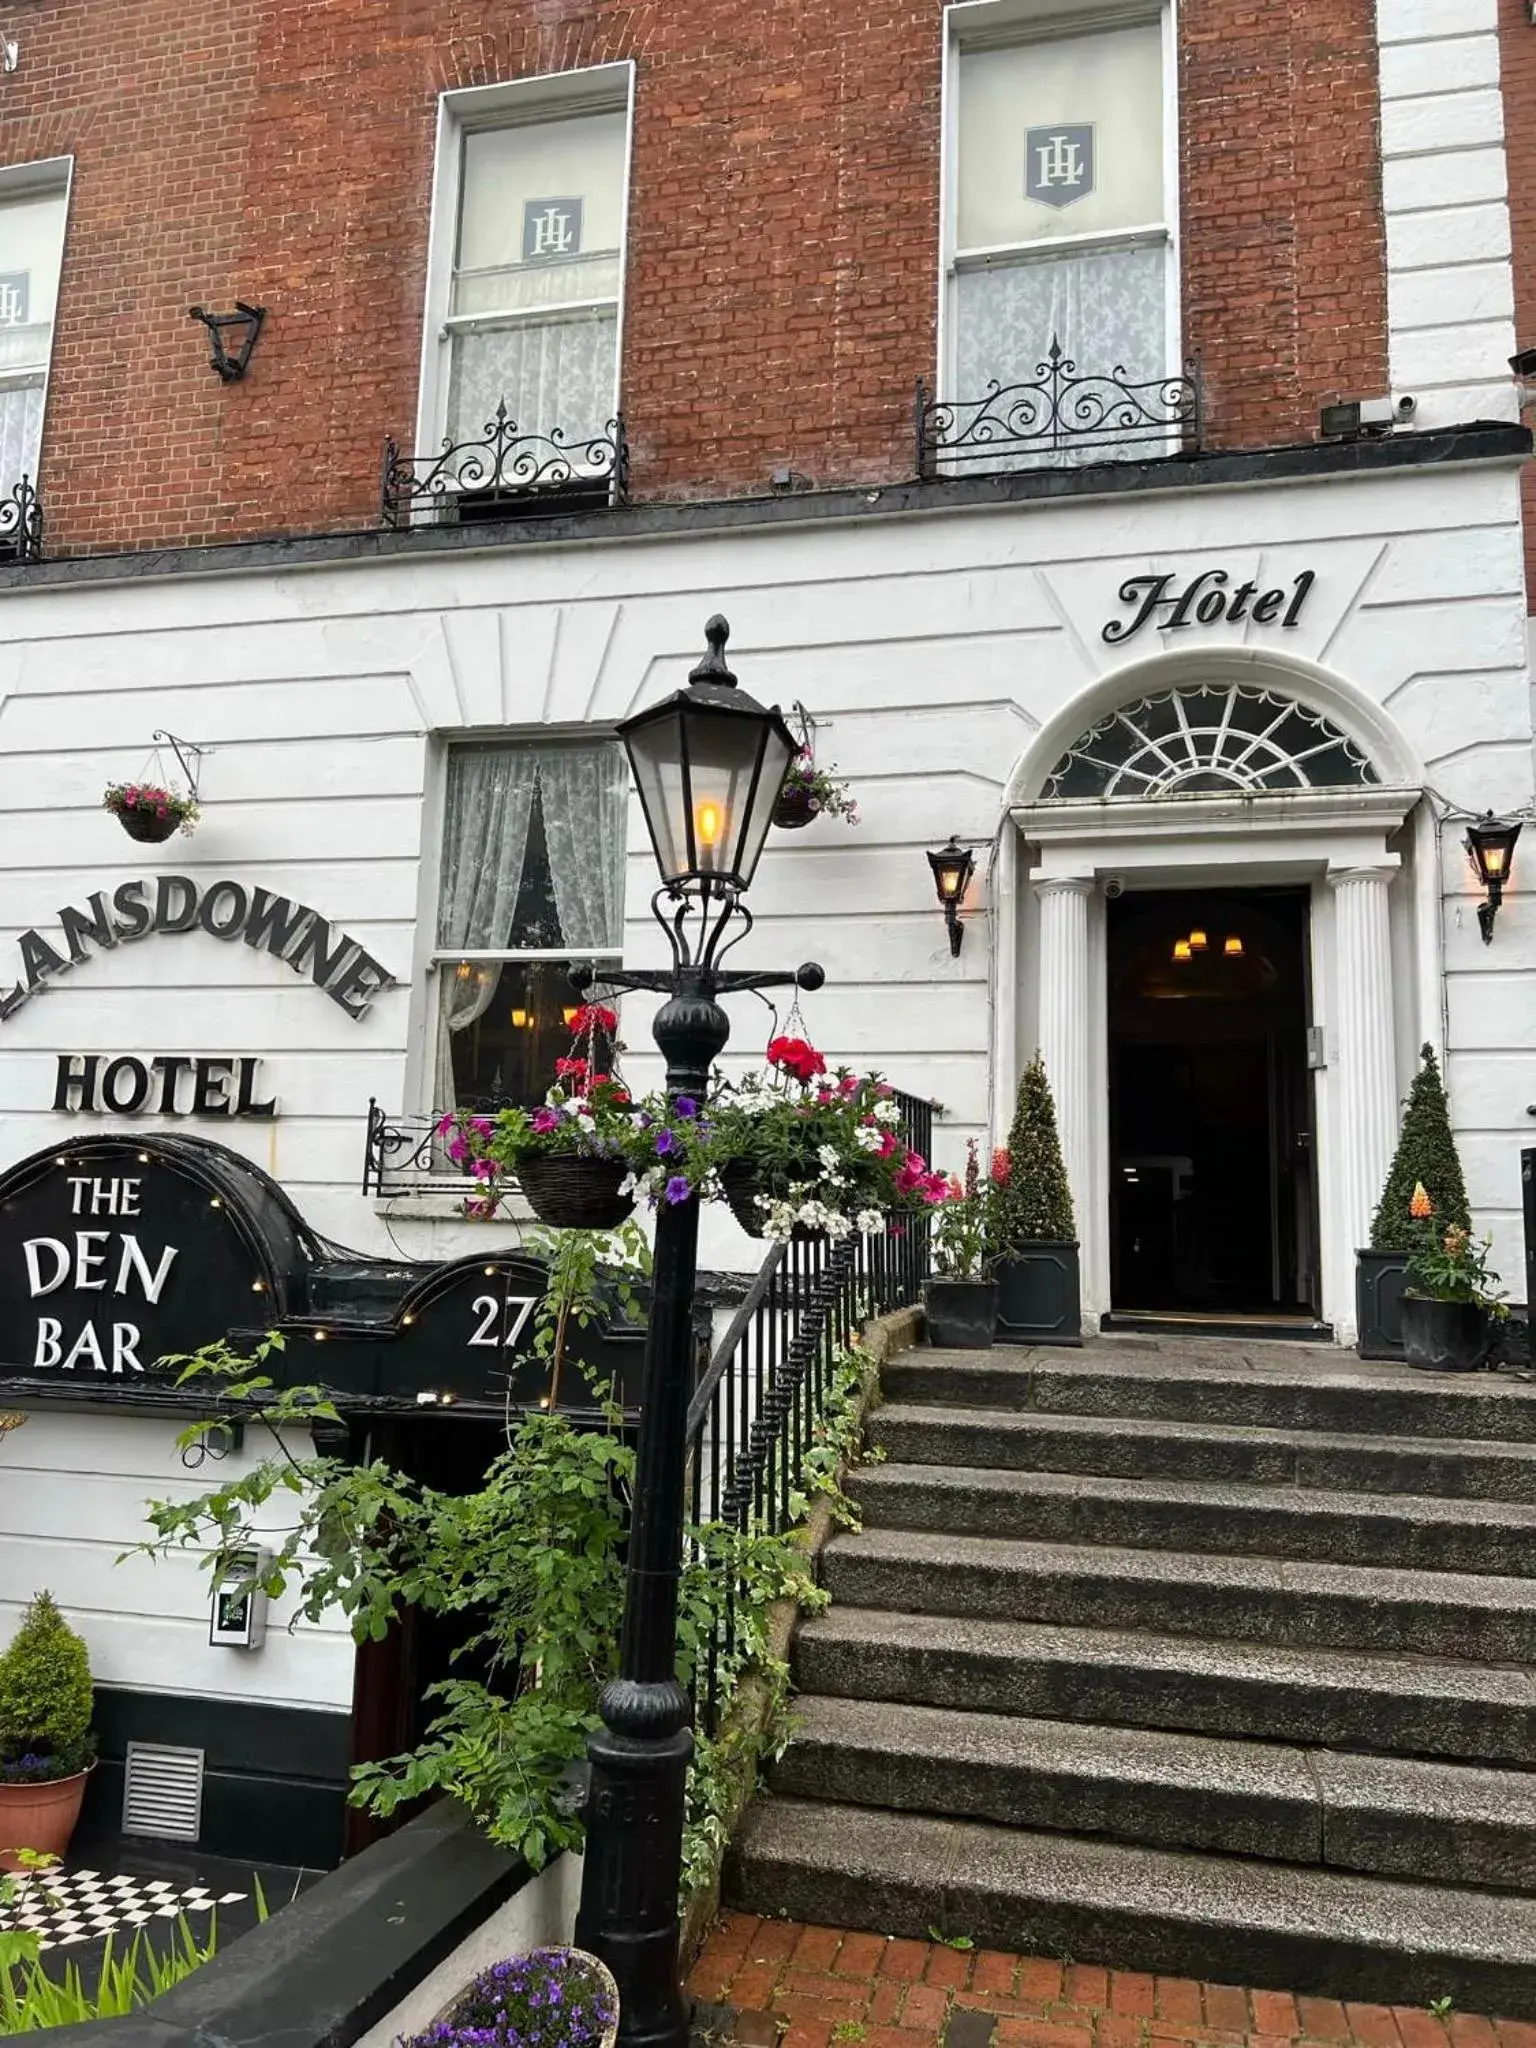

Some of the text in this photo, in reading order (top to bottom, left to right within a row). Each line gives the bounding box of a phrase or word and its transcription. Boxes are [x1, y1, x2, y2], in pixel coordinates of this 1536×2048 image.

[1101, 569, 1316, 643] Hotel
[52, 1054, 279, 1116] HOTEL
[67, 1177, 143, 1216] THE
[22, 1231, 179, 1305] DEN
[34, 1317, 145, 1373] BAR
[467, 1295, 539, 1347] 27
